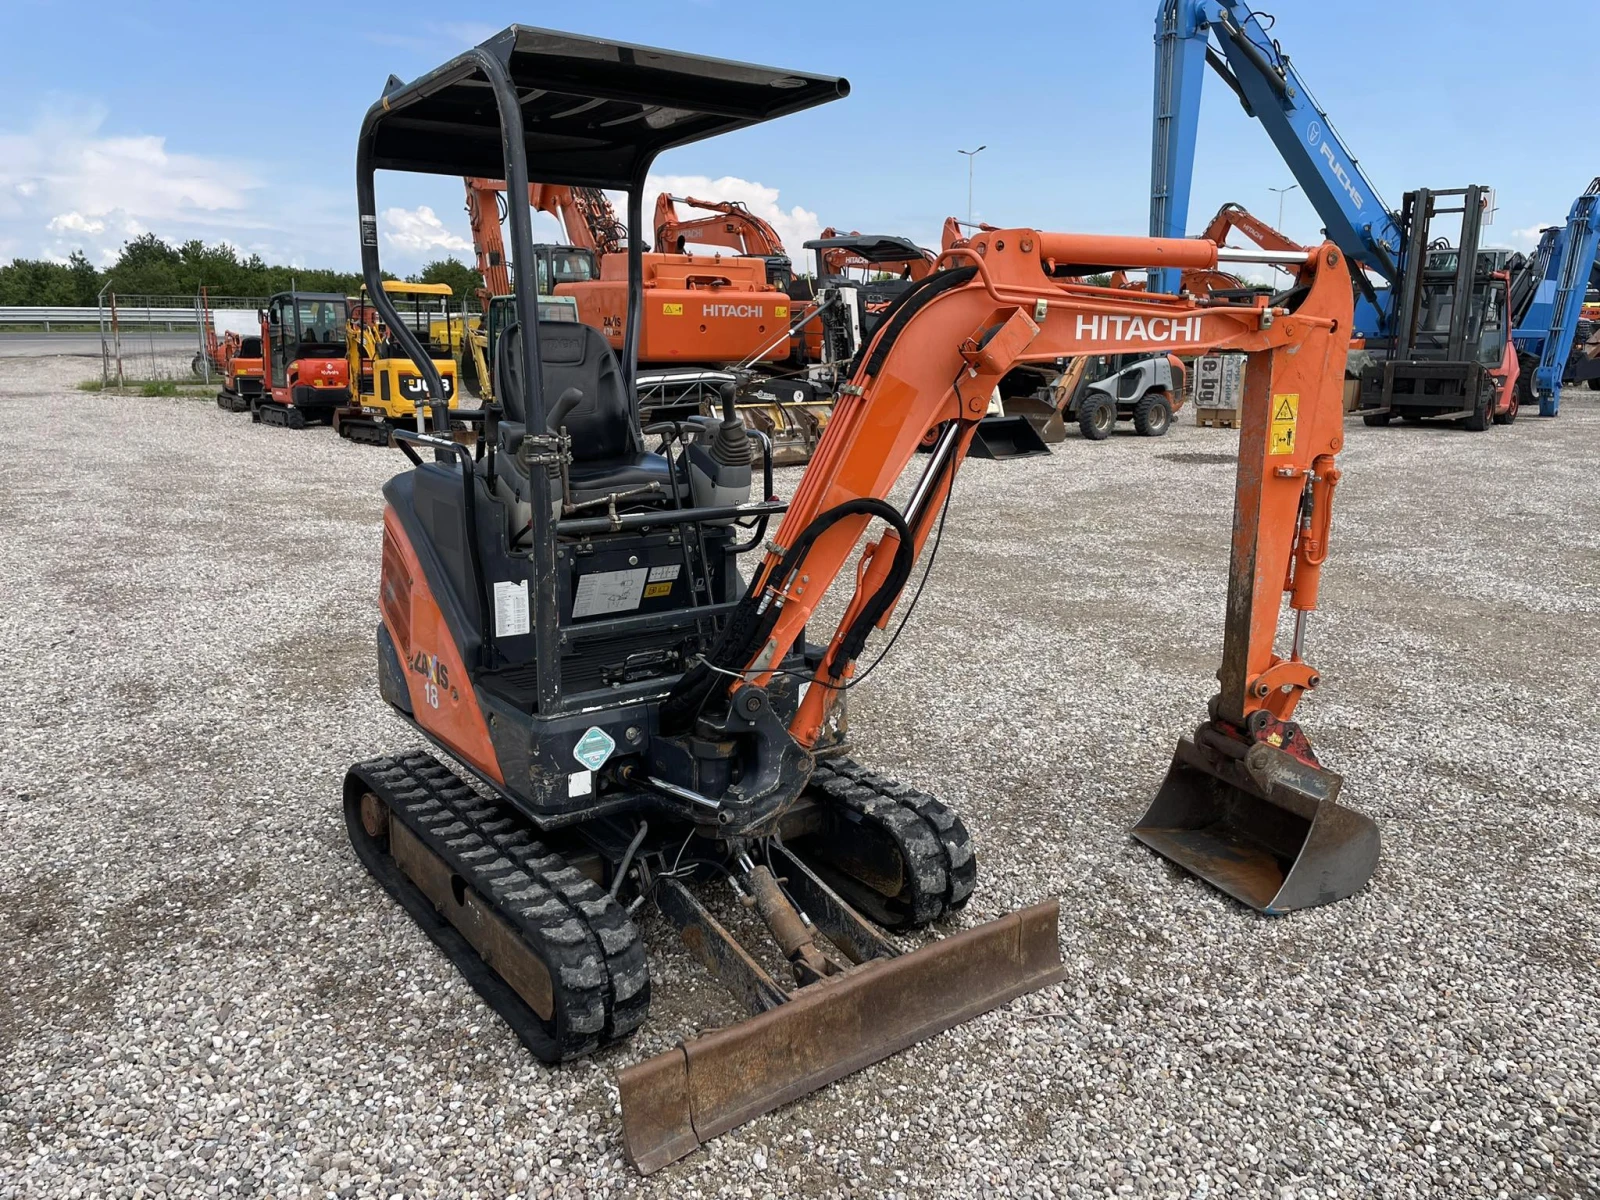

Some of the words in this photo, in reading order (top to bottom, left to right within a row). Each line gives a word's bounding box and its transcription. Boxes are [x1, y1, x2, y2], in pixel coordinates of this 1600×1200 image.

[1319, 141, 1364, 210] FUCHS
[1242, 223, 1264, 241] HITACHI
[702, 304, 763, 318] HITACHI
[1075, 314, 1202, 342] HITACHI
[424, 681, 439, 709] 18
